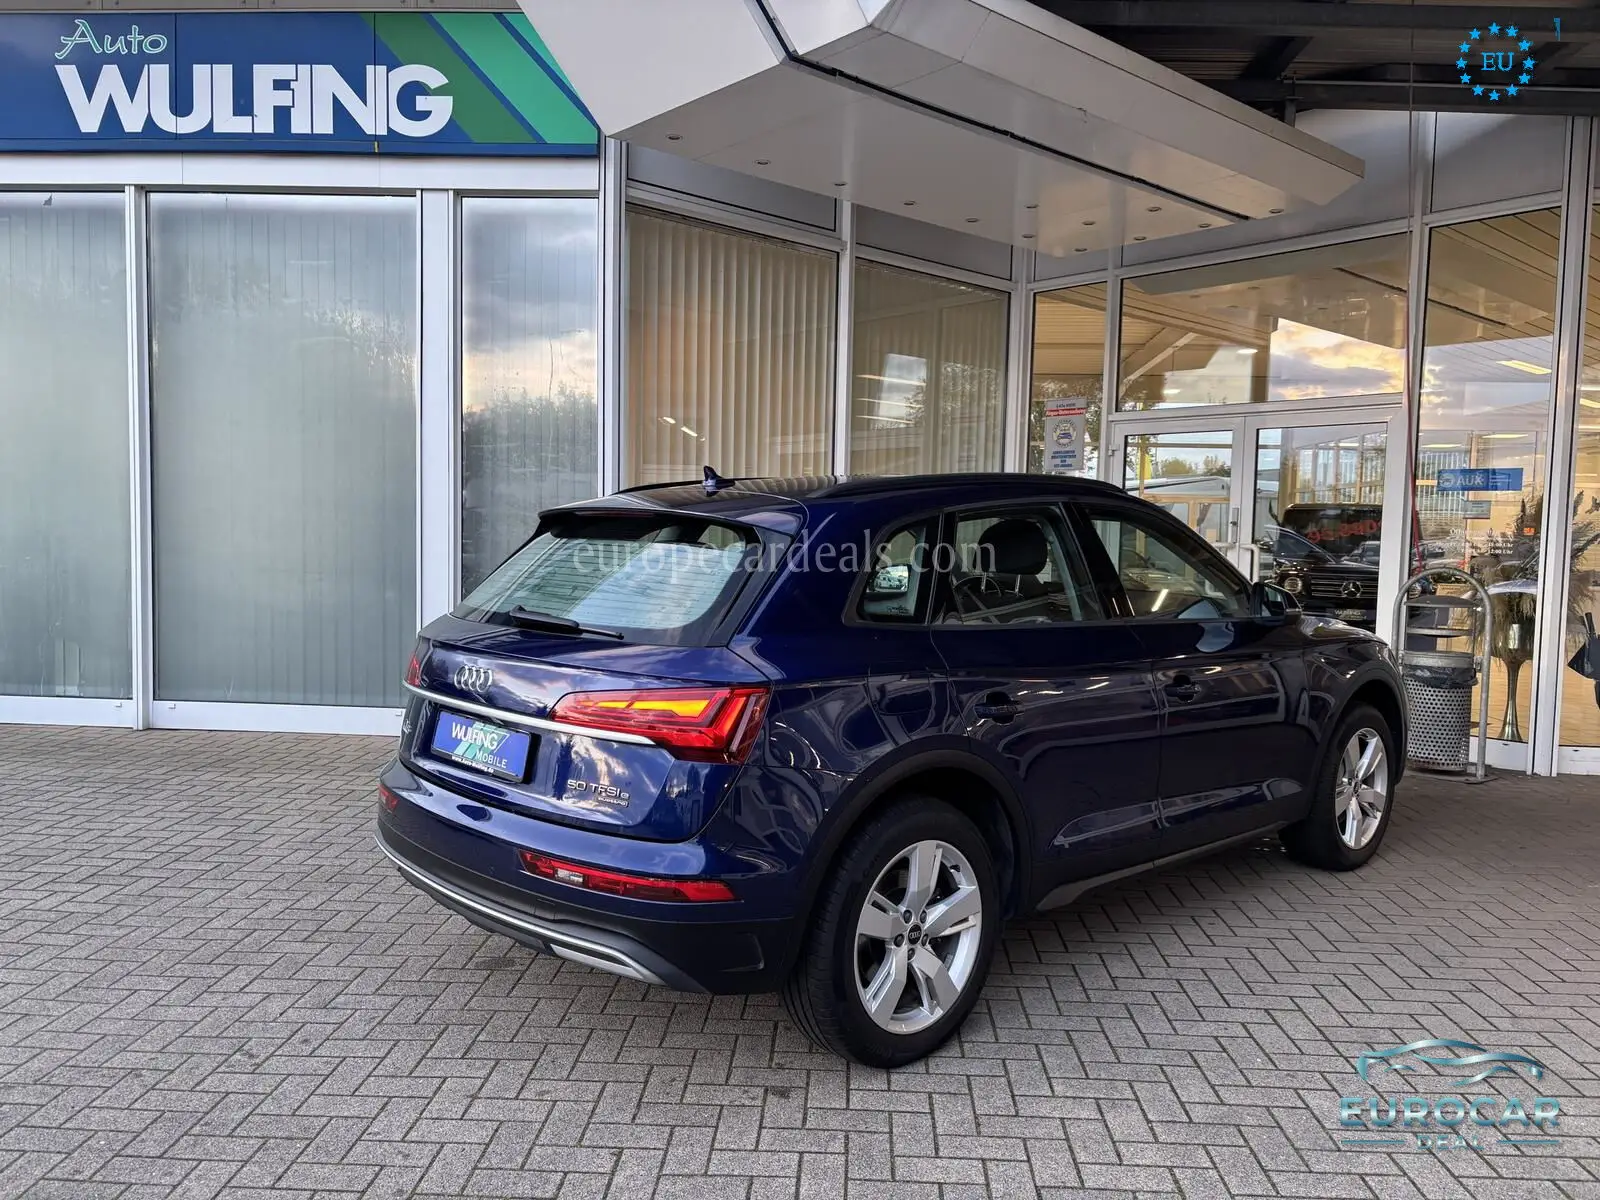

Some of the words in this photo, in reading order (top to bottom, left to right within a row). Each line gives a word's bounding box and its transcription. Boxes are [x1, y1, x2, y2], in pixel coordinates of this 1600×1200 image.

[55, 19, 168, 60] Auto
[54, 63, 454, 138] WULFING
[451, 721, 498, 750] WULFING
[476, 749, 508, 769] MOBILE
[567, 779, 587, 791] 50
[590, 783, 621, 797] TFSI
